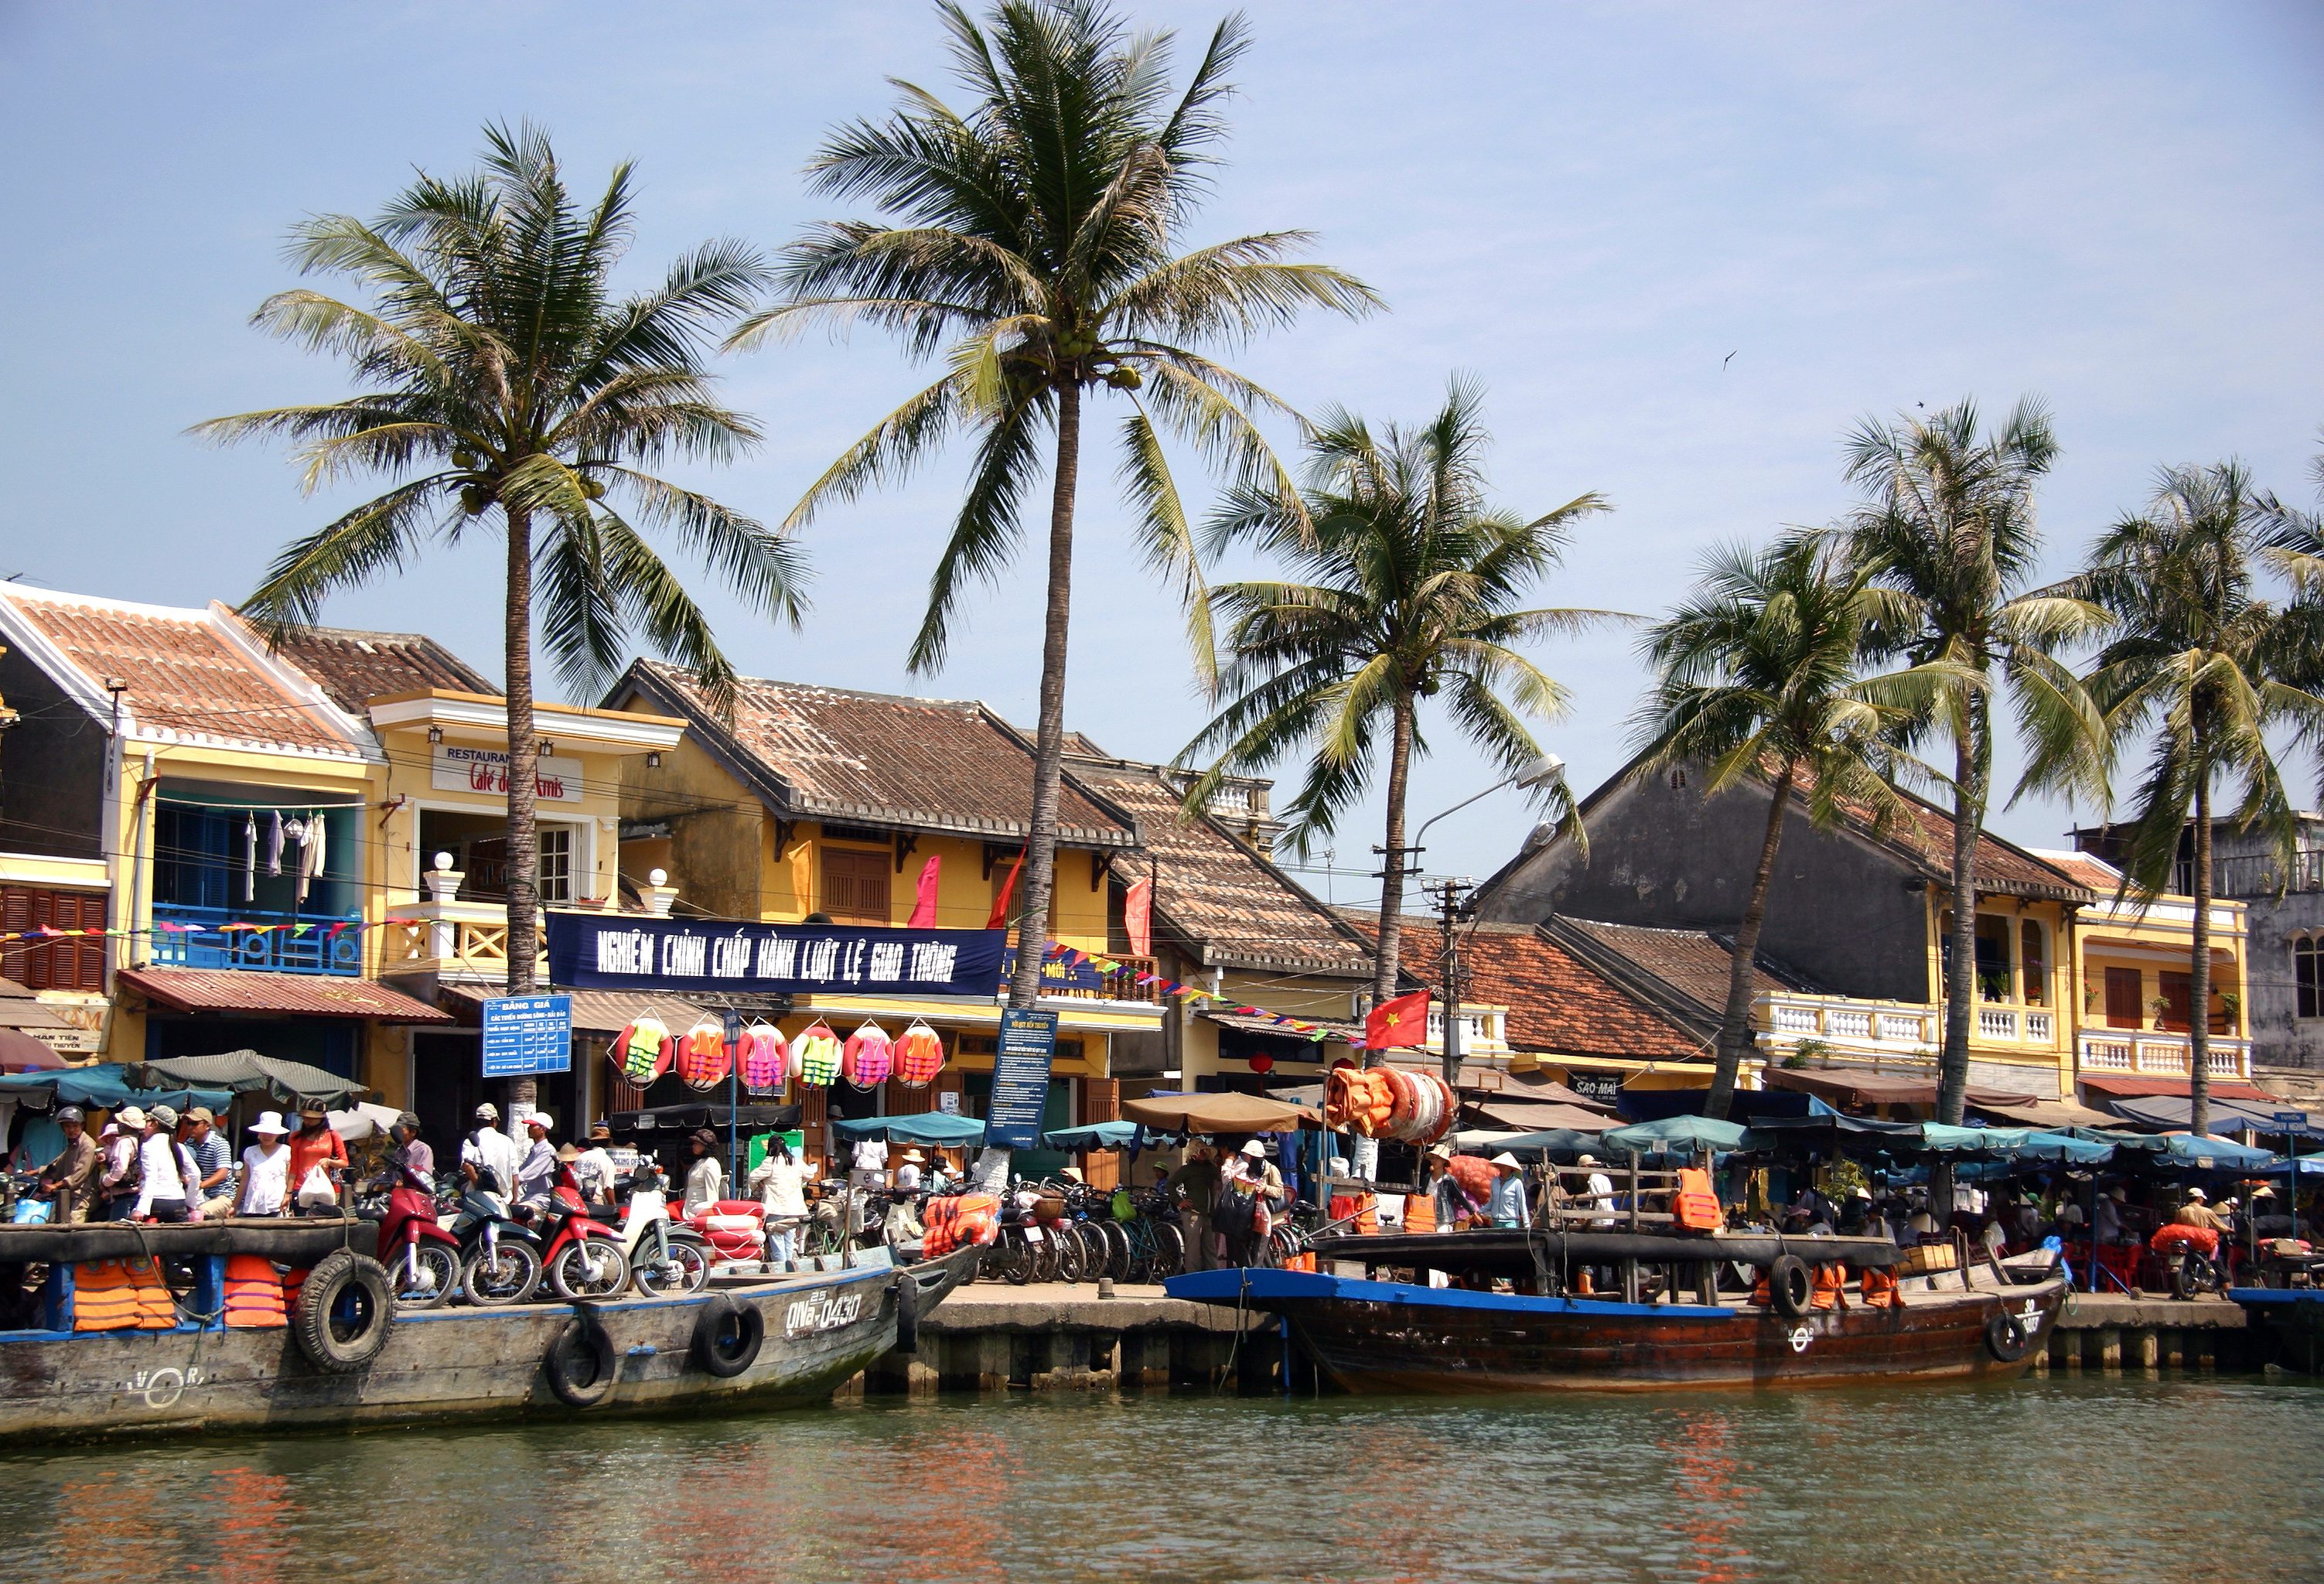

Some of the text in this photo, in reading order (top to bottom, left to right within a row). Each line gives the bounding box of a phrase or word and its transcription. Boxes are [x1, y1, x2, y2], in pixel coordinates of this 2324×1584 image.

[448, 747, 510, 763] RESTAURAN
[470, 763, 496, 791] Café
[597, 928, 655, 975] NGHIÊM
[662, 928, 707, 977] CHỈNH
[712, 927, 752, 978] CHẤP
[756, 930, 798, 979] HÀNH
[800, 937, 841, 985] LUẬT
[844, 937, 866, 985] LỆ
[869, 942, 904, 981] GIAO
[909, 940, 958, 983] THÔNG
[502, 1001, 529, 1010] BẢNG
[534, 999, 550, 1009] GIÁ
[1575, 1082, 1595, 1094] SAO
